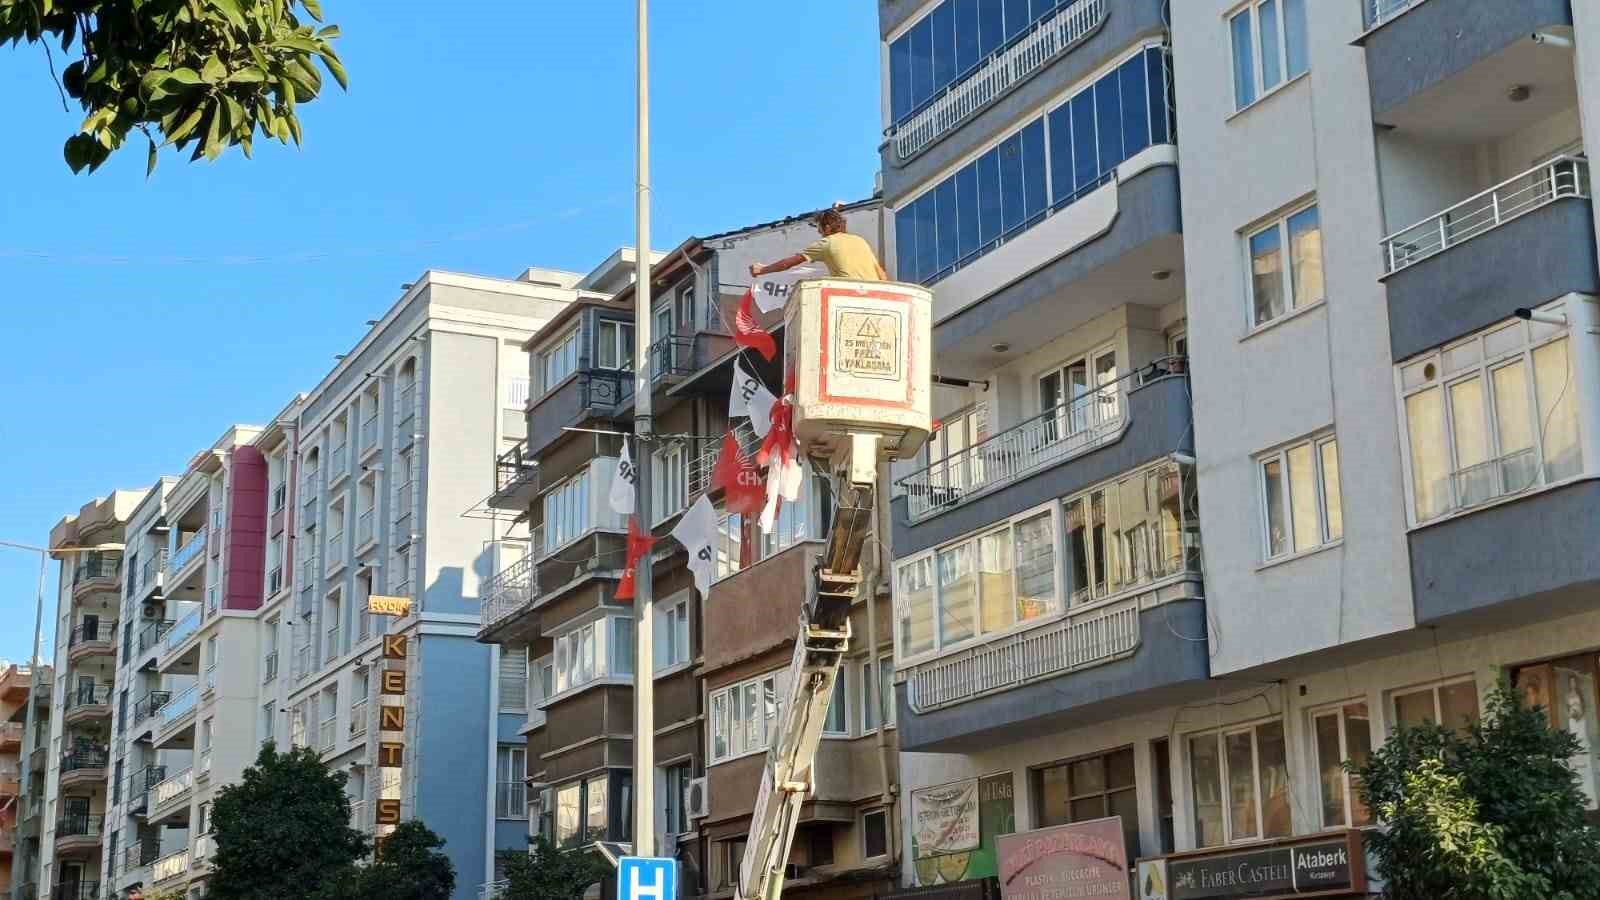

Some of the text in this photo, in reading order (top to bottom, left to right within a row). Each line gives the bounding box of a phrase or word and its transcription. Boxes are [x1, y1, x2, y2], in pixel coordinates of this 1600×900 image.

[382, 636, 406, 764] KENT
[1297, 848, 1347, 869] Ataberk
[630, 865, 664, 900] H
